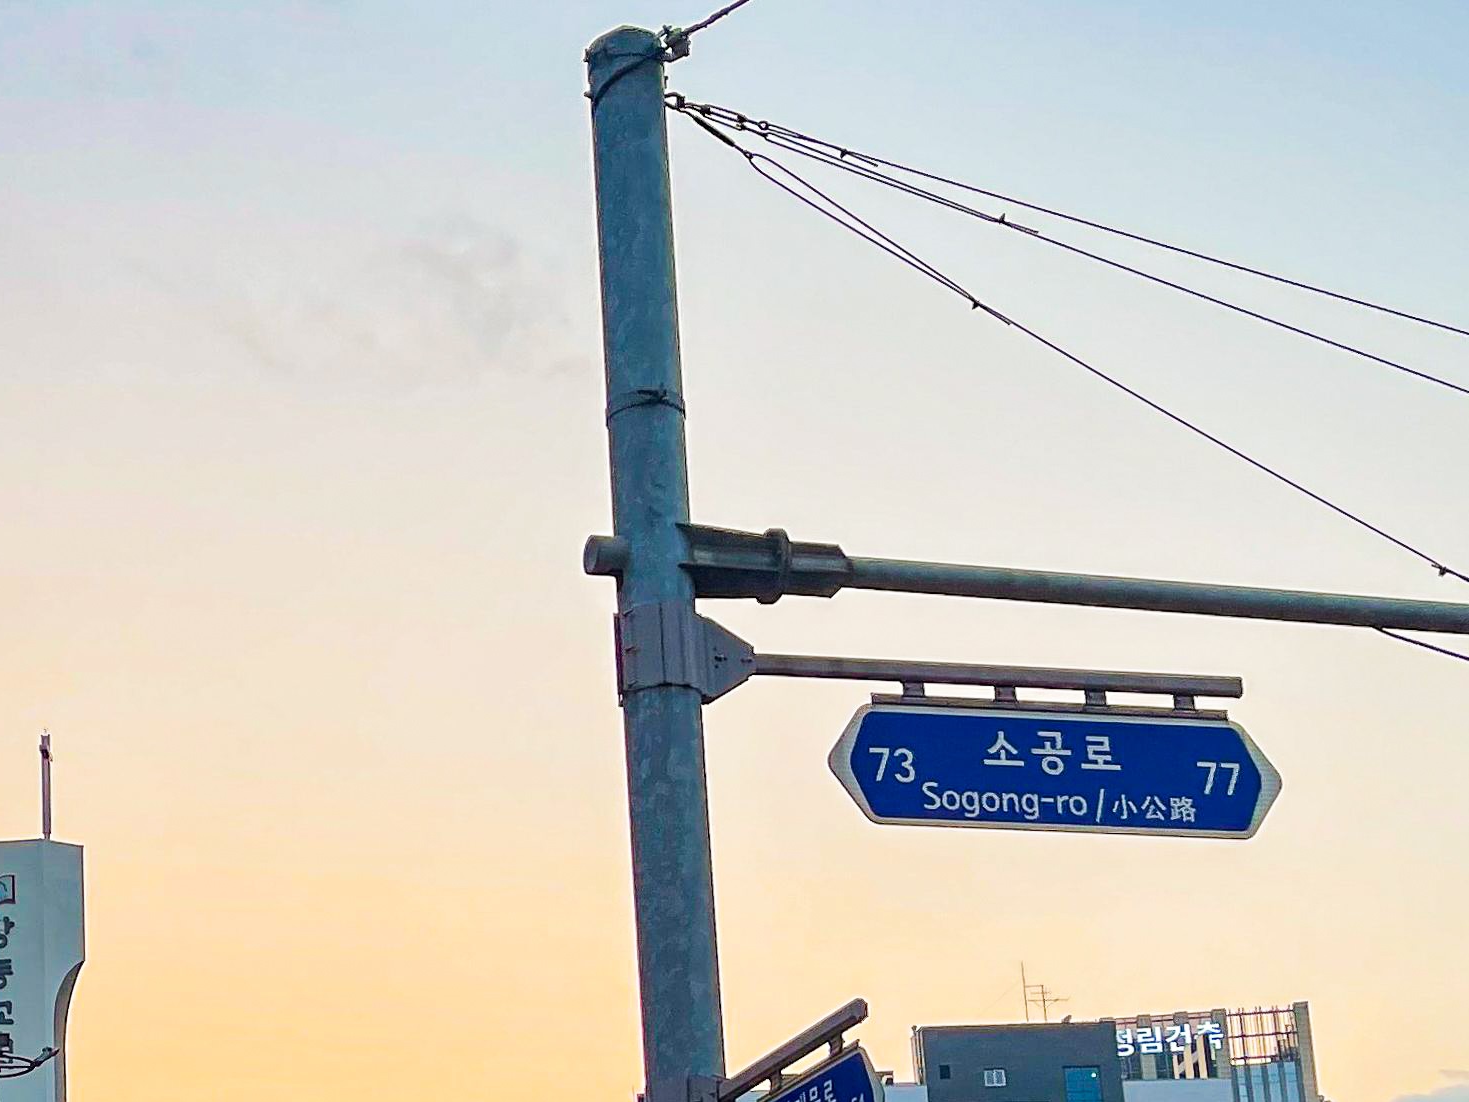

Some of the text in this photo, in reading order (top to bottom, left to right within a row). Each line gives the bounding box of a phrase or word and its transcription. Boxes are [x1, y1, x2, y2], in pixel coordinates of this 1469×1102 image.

[869, 747, 916, 783] 73
[984, 730, 1122, 775] 소공로
[1196, 761, 1240, 795] 77
[921, 781, 1197, 823] Sogong-ro 小公路
